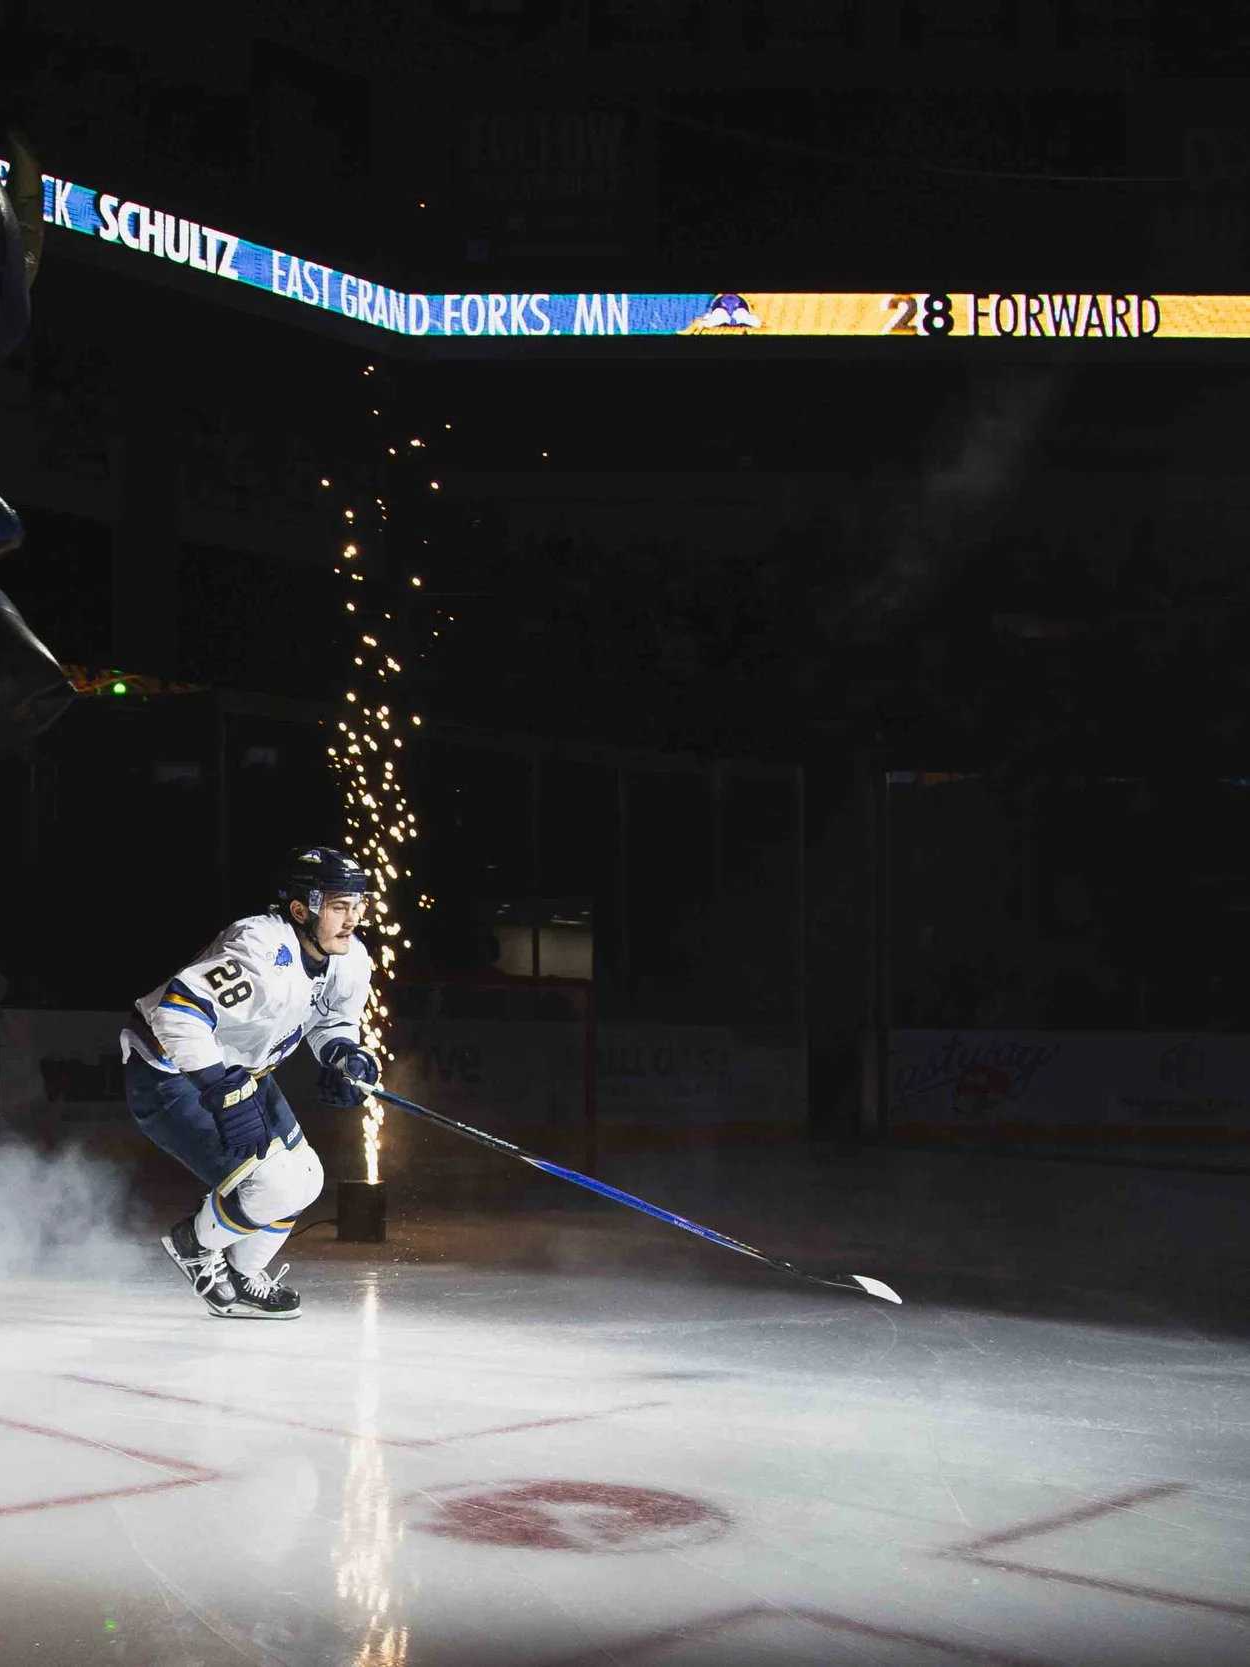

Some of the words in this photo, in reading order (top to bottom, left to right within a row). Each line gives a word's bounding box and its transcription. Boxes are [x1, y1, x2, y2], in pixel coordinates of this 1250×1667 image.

[99, 194, 239, 281] SCHULTZ
[272, 250, 333, 309] EAST
[341, 273, 430, 336] GRAND
[573, 293, 629, 336] MN
[887, 296, 954, 336] 28
[973, 294, 1160, 337] FORWARD
[203, 958, 255, 1009] 28
